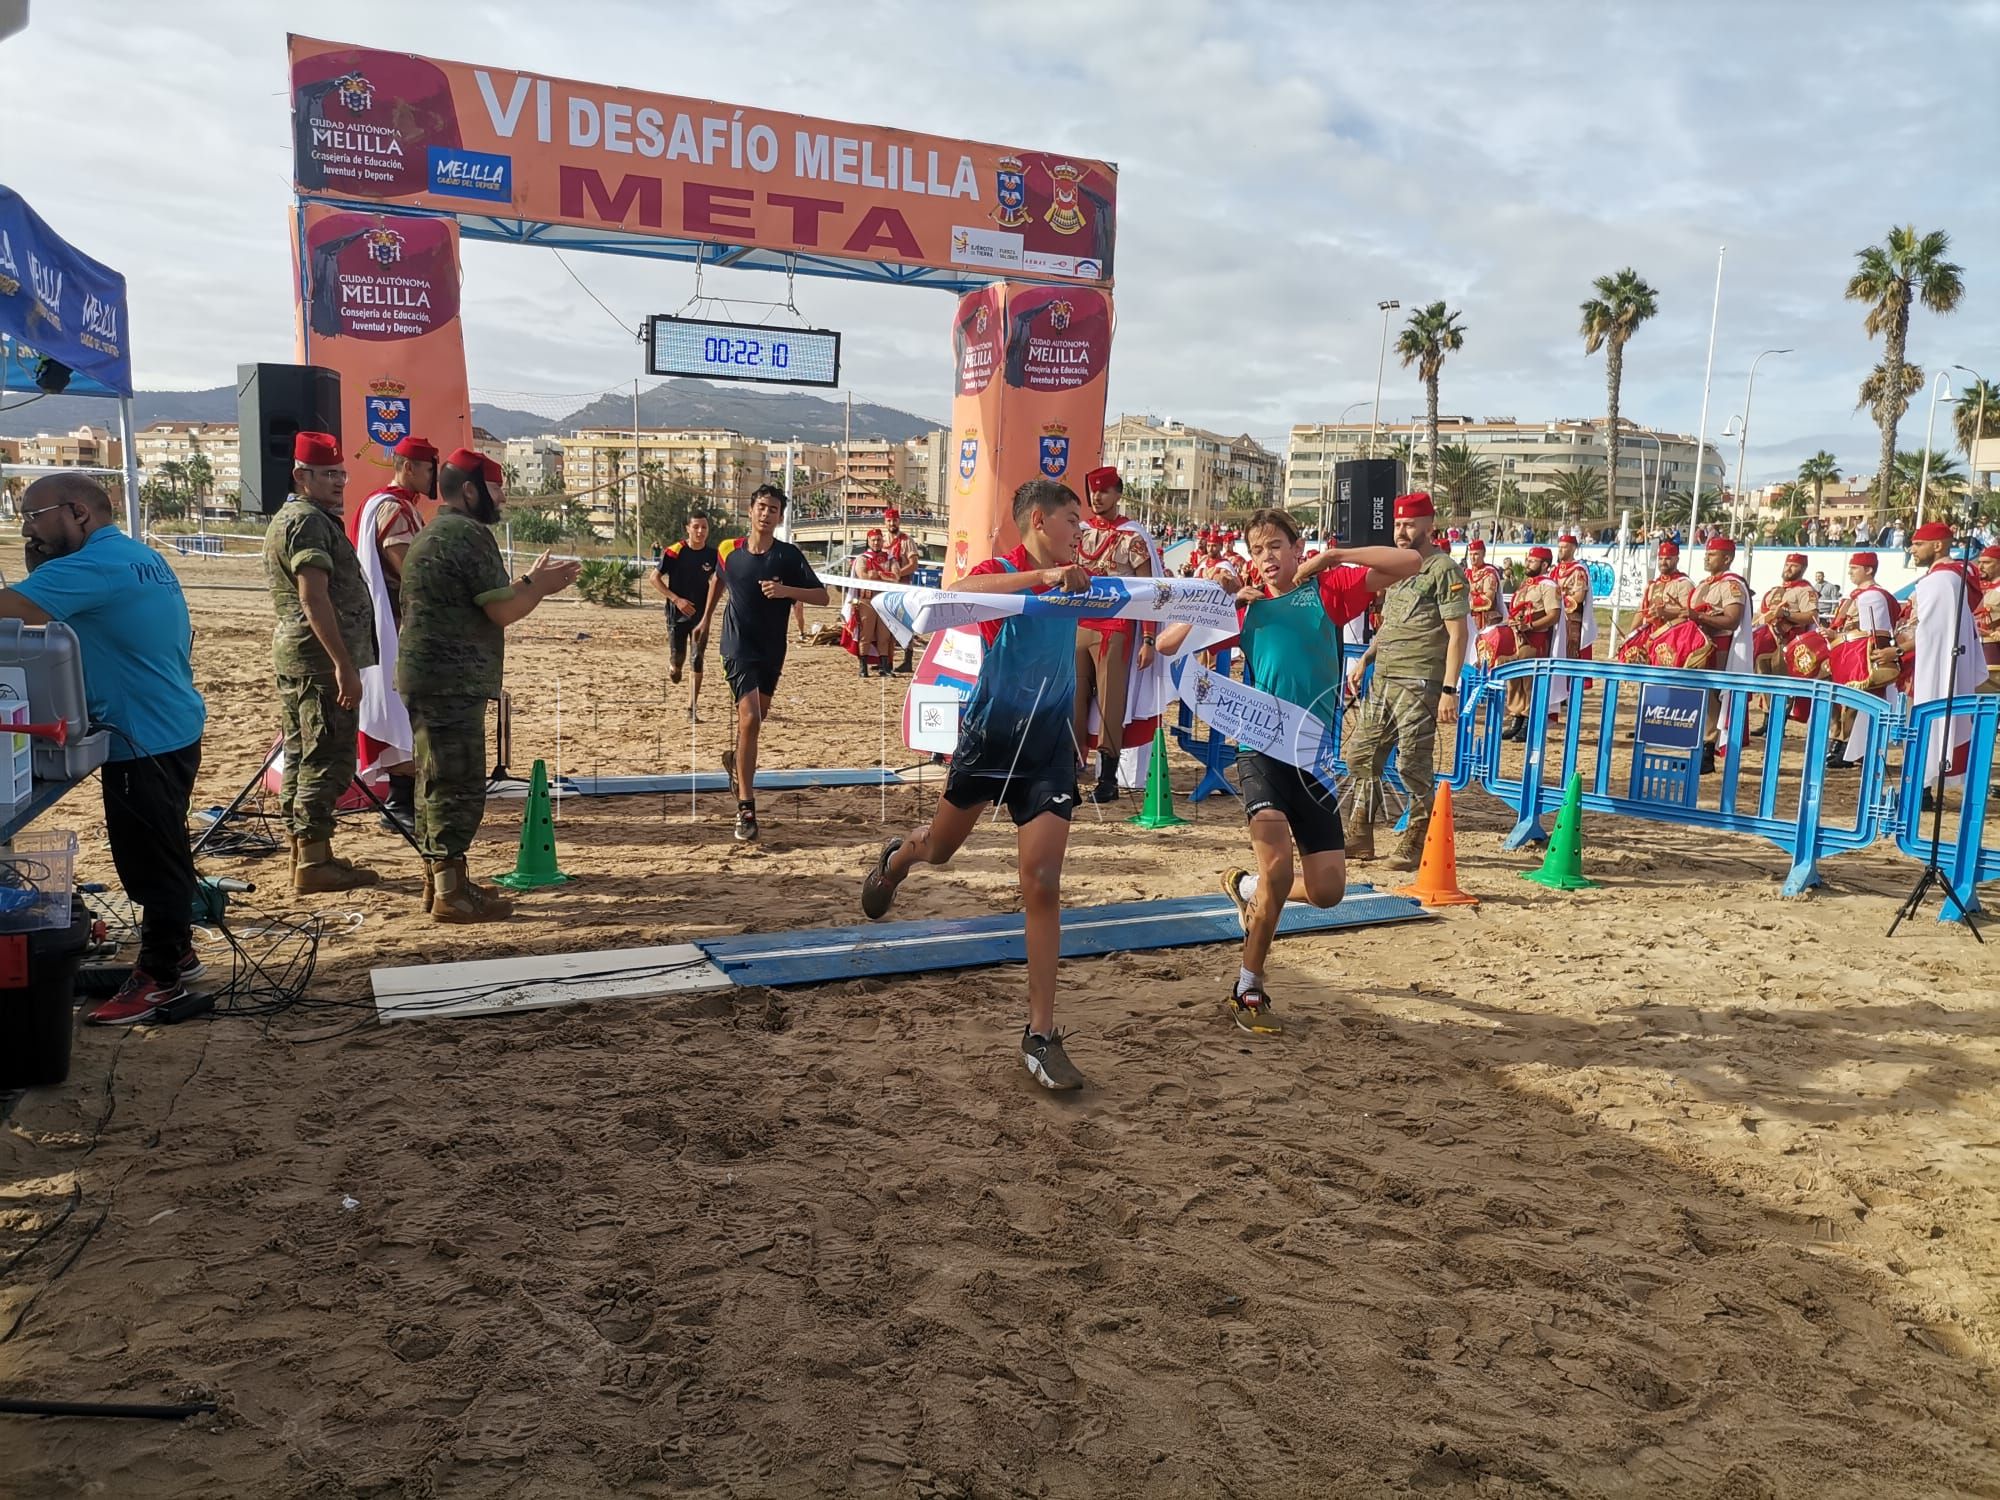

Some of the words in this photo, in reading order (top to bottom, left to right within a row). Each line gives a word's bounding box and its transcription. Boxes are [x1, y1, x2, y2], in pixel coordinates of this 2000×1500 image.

[310, 117, 344, 129] CIUDAD
[347, 123, 401, 137] AUTÓNOMA
[474, 70, 551, 143] VI
[568, 96, 778, 173] DESAFÍO
[795, 131, 980, 201] MELILLA
[312, 128, 403, 156] MELILLA
[353, 155, 362, 164] de
[364, 156, 405, 171] Educación,
[437, 160, 503, 183] MELILLA
[323, 164, 355, 177] Juventud
[357, 170, 363, 179] y
[364, 169, 394, 181] Deporte
[559, 165, 924, 259] META
[339, 274, 374, 284] CIUDAD
[376, 276, 431, 289] AUTÓNOMA
[342, 284, 431, 309] MELILLA
[82, 293, 117, 343] MELILLA
[341, 306, 380, 319] Consejería
[382, 309, 391, 318] de
[393, 309, 431, 323] Educación,
[352, 320, 385, 332] Juventud
[387, 324, 392, 333] y
[393, 322, 422, 334] Deporte
[1030, 338, 1051, 346] CIUDAD
[1051, 340, 1090, 348] AUTÓNOMA
[965, 350, 992, 368] MELILLA
[1028, 345, 1089, 364] MELILLA
[1030, 376, 1054, 384] Juventud
[1060, 377, 1082, 386] Deporte
[1373, 497, 1384, 530] DEXFIRE
[1201, 605, 1208, 613] de
[1220, 687, 1246, 702] CIUDAD
[1217, 694, 1284, 736] MELILLA
[1645, 705, 1698, 724] MELILLA
[1244, 723, 1252, 731] de
[1241, 733, 1264, 749] Deporte
